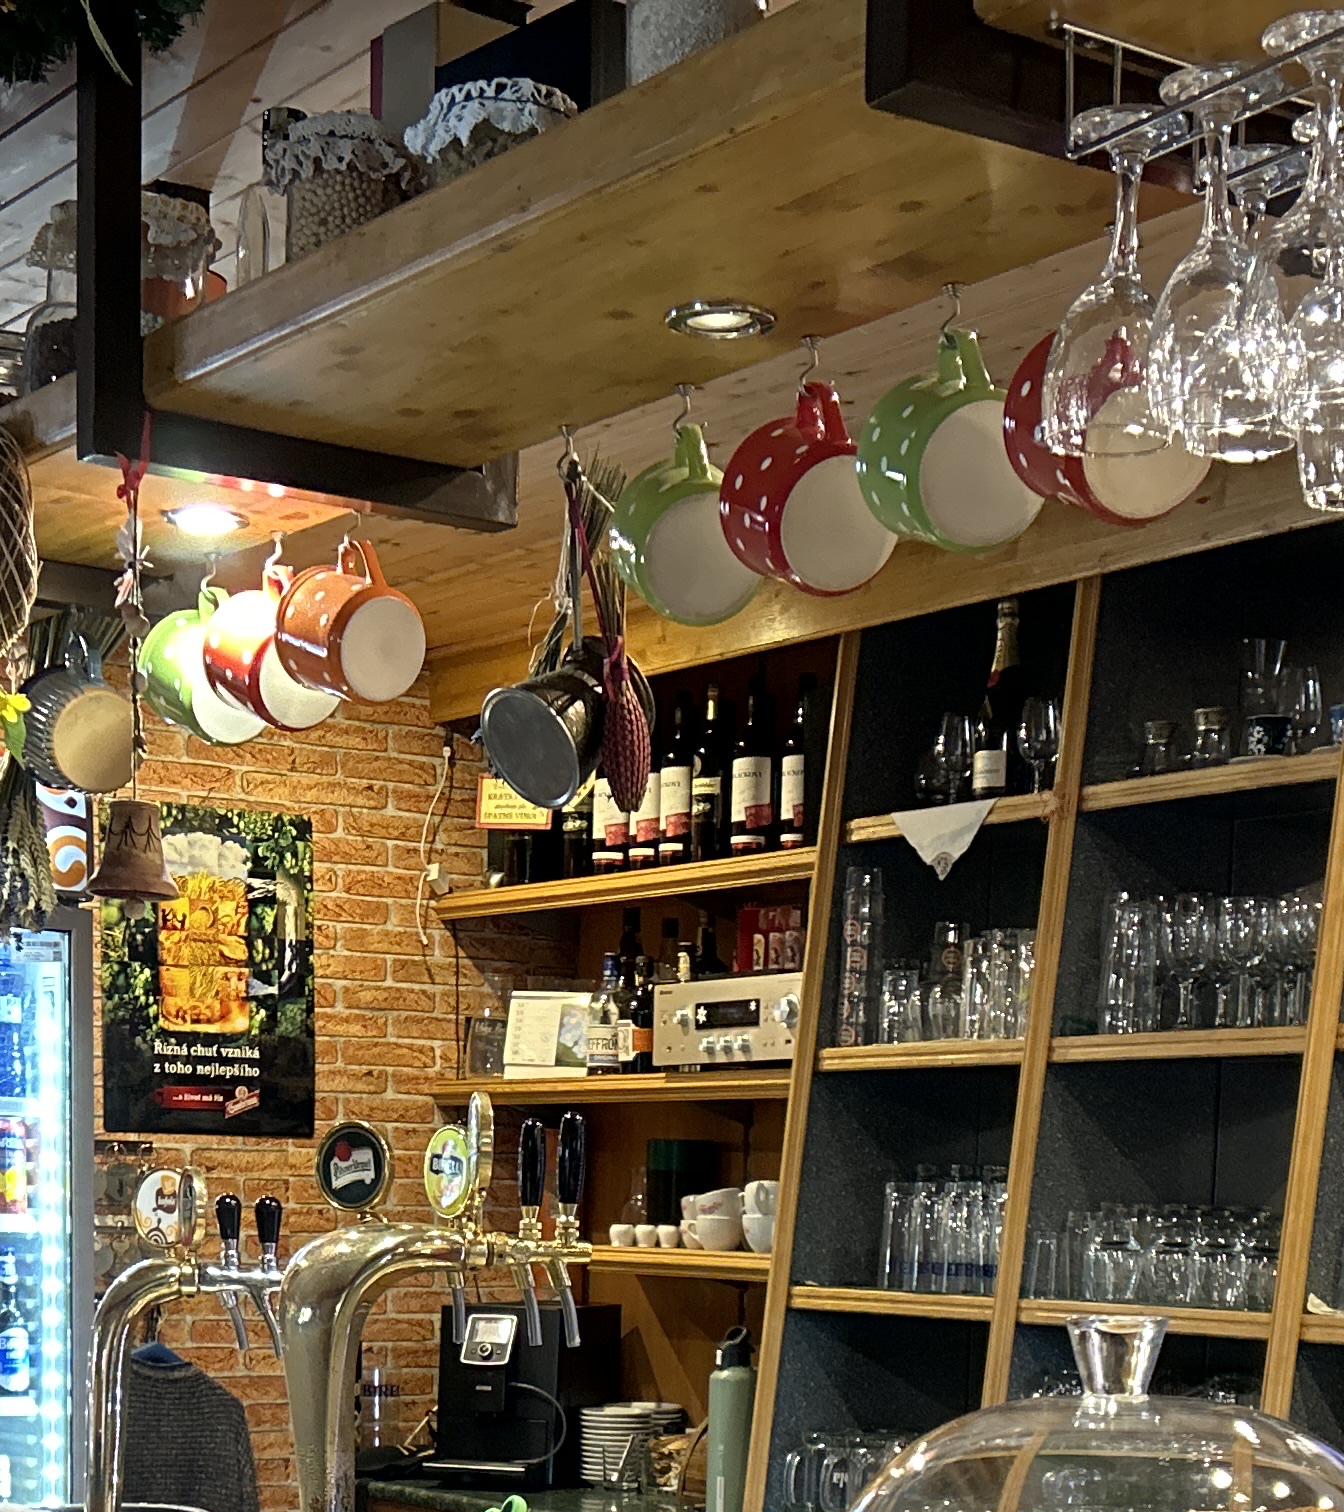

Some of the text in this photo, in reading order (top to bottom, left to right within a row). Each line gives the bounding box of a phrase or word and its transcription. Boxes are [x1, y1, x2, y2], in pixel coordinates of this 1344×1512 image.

[154, 1039, 260, 1058] Řízná chuť vzniká
[153, 1061, 260, 1078] z toho nejlepšího
